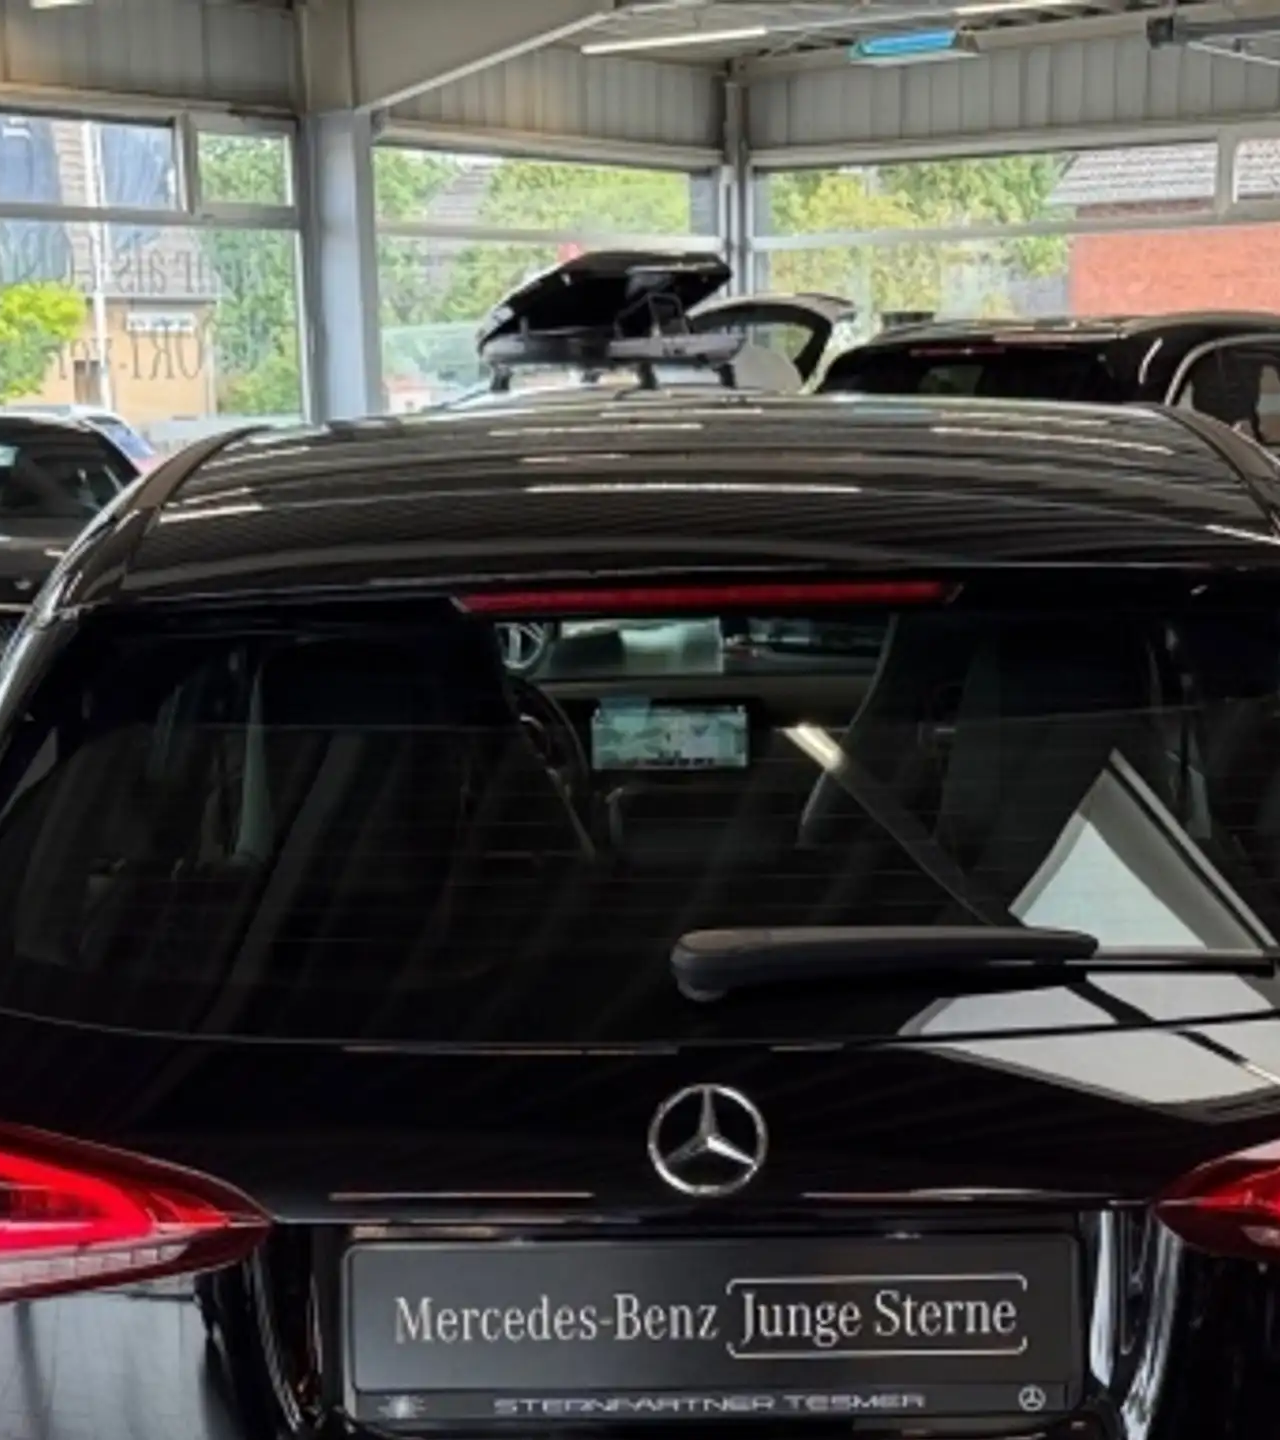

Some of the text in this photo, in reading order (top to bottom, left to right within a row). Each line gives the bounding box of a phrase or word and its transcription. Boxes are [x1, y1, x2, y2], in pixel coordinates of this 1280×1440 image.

[395, 1289, 1017, 1348] Mercedes-Benz Junge Sterne
[493, 1394, 926, 1415] STERNPARTNER TESMER
